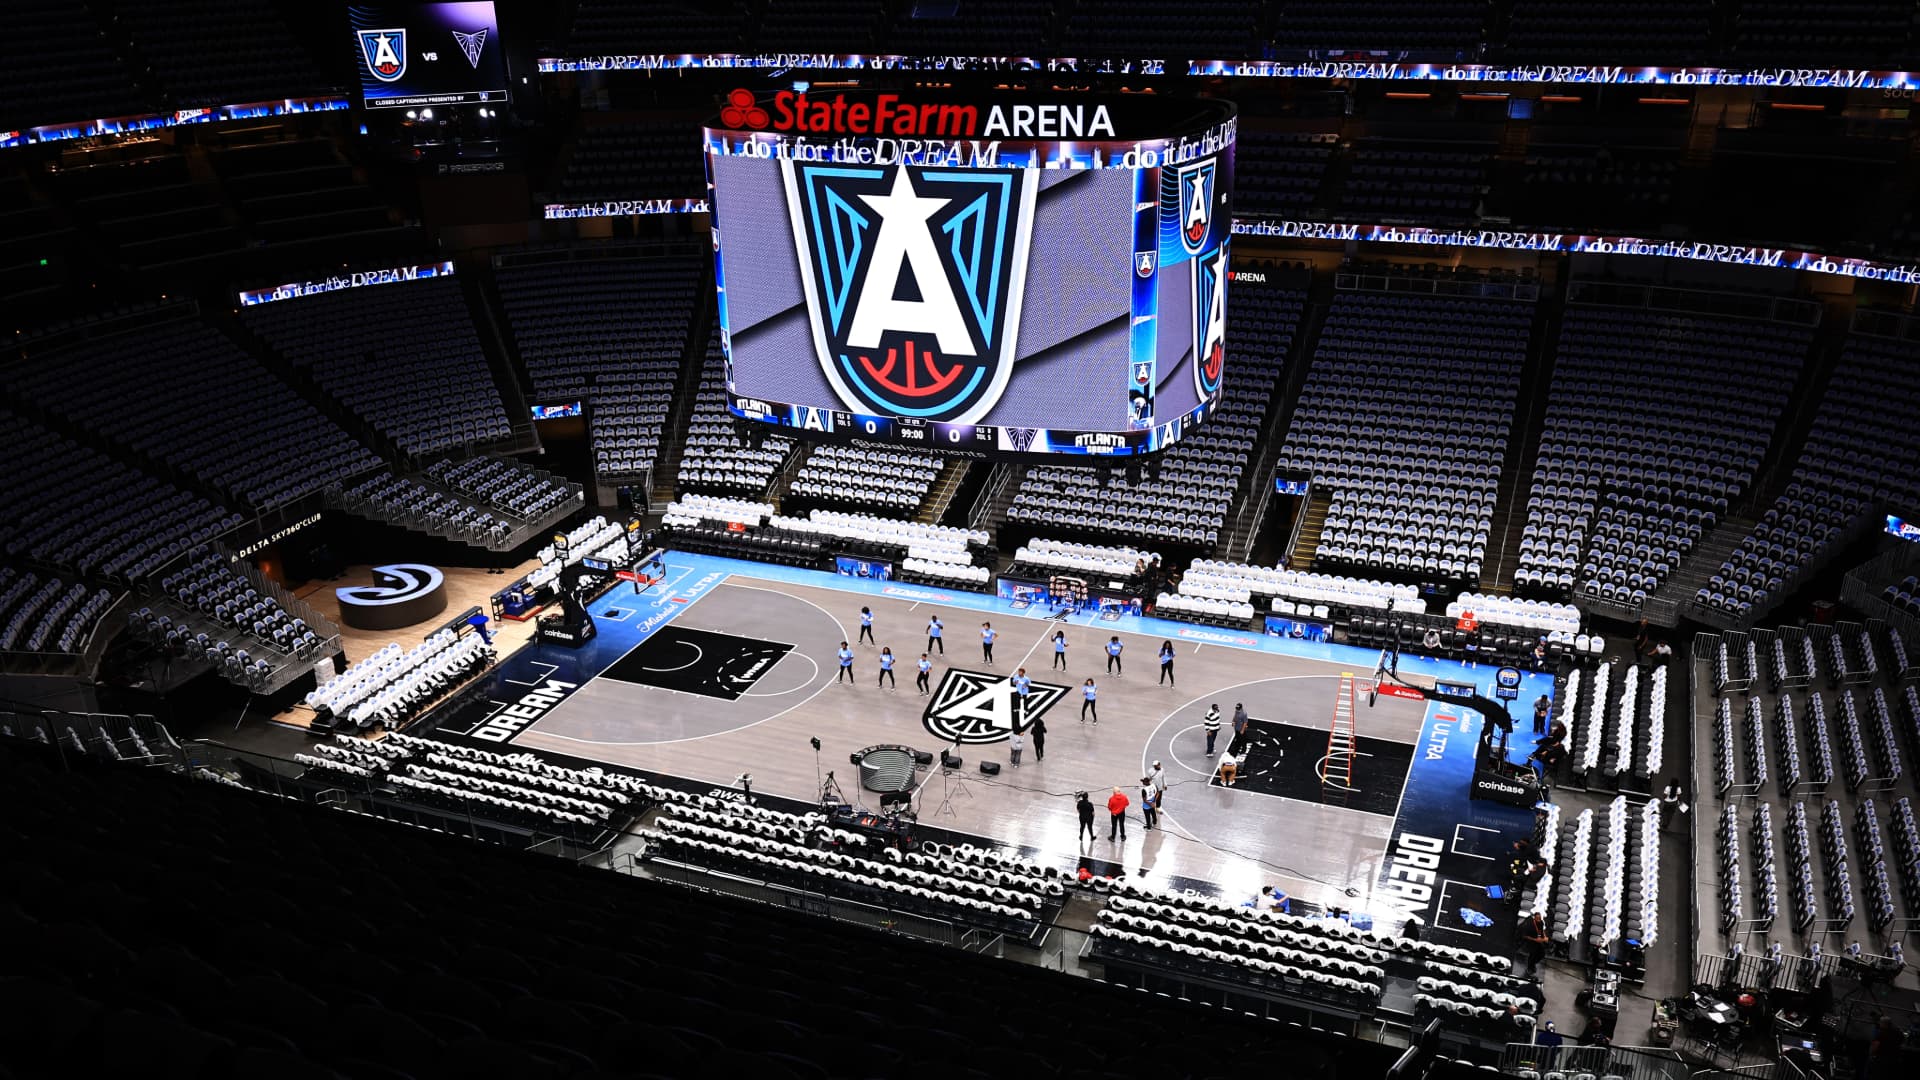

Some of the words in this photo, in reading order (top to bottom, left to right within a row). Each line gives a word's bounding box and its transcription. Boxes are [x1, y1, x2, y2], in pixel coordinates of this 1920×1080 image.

[558, 59, 576, 71] for
[580, 57, 600, 70] the
[601, 55, 664, 70] DREAM
[704, 55, 720, 68] do
[735, 56, 752, 68] for
[756, 55, 776, 68] the
[777, 53, 835, 68] DREAM
[1238, 62, 1254, 76] do
[1272, 62, 1293, 77] for
[1297, 62, 1321, 78] the
[1322, 62, 1398, 80] DREAM
[1446, 65, 1464, 80] do
[1485, 65, 1507, 81] for
[1511, 64, 1537, 82] the
[1538, 66, 1622, 84] DREAM
[1674, 70, 1696, 85] do
[1716, 70, 1741, 86] for
[1746, 68, 1774, 87] the
[1775, 68, 1870, 89] DREAM
[984, 104, 1116, 137] ARENA
[744, 136, 770, 160] do
[776, 136, 789, 160] it
[796, 137, 831, 162] for
[833, 138, 871, 164] the
[876, 138, 1001, 168] DREAM
[1122, 142, 1158, 169] do
[1162, 140, 1176, 166] it
[1176, 136, 1200, 164] for
[1200, 127, 1218, 156] the
[581, 202, 603, 217] the
[605, 200, 672, 216] DREAM
[1256, 220, 1280, 236] the
[1282, 220, 1359, 241] DREAM
[1385, 226, 1406, 242] do
[1451, 228, 1477, 246] the
[1478, 230, 1564, 250] DREAM
[1590, 238, 1614, 254] do
[1662, 240, 1691, 258] the
[1692, 241, 1786, 268] DREAM
[1814, 257, 1838, 274] do
[272, 286, 292, 301] do
[294, 283, 304, 298] it
[327, 275, 350, 292] the
[351, 266, 418, 288] DREAM
[1235, 272, 1266, 283] ARENA
[736, 398, 772, 416] ATLANTA
[866, 420, 876, 434] 0
[901, 428, 924, 440] 99:00
[948, 429, 960, 442] 0
[1075, 433, 1126, 448] ATLANTA
[240, 538, 270, 558] DELTA
[681, 572, 724, 598] ULTRA
[470, 679, 578, 743] DREAM
[1425, 723, 1452, 760] ULTRA
[1478, 780, 1525, 795] coinbase
